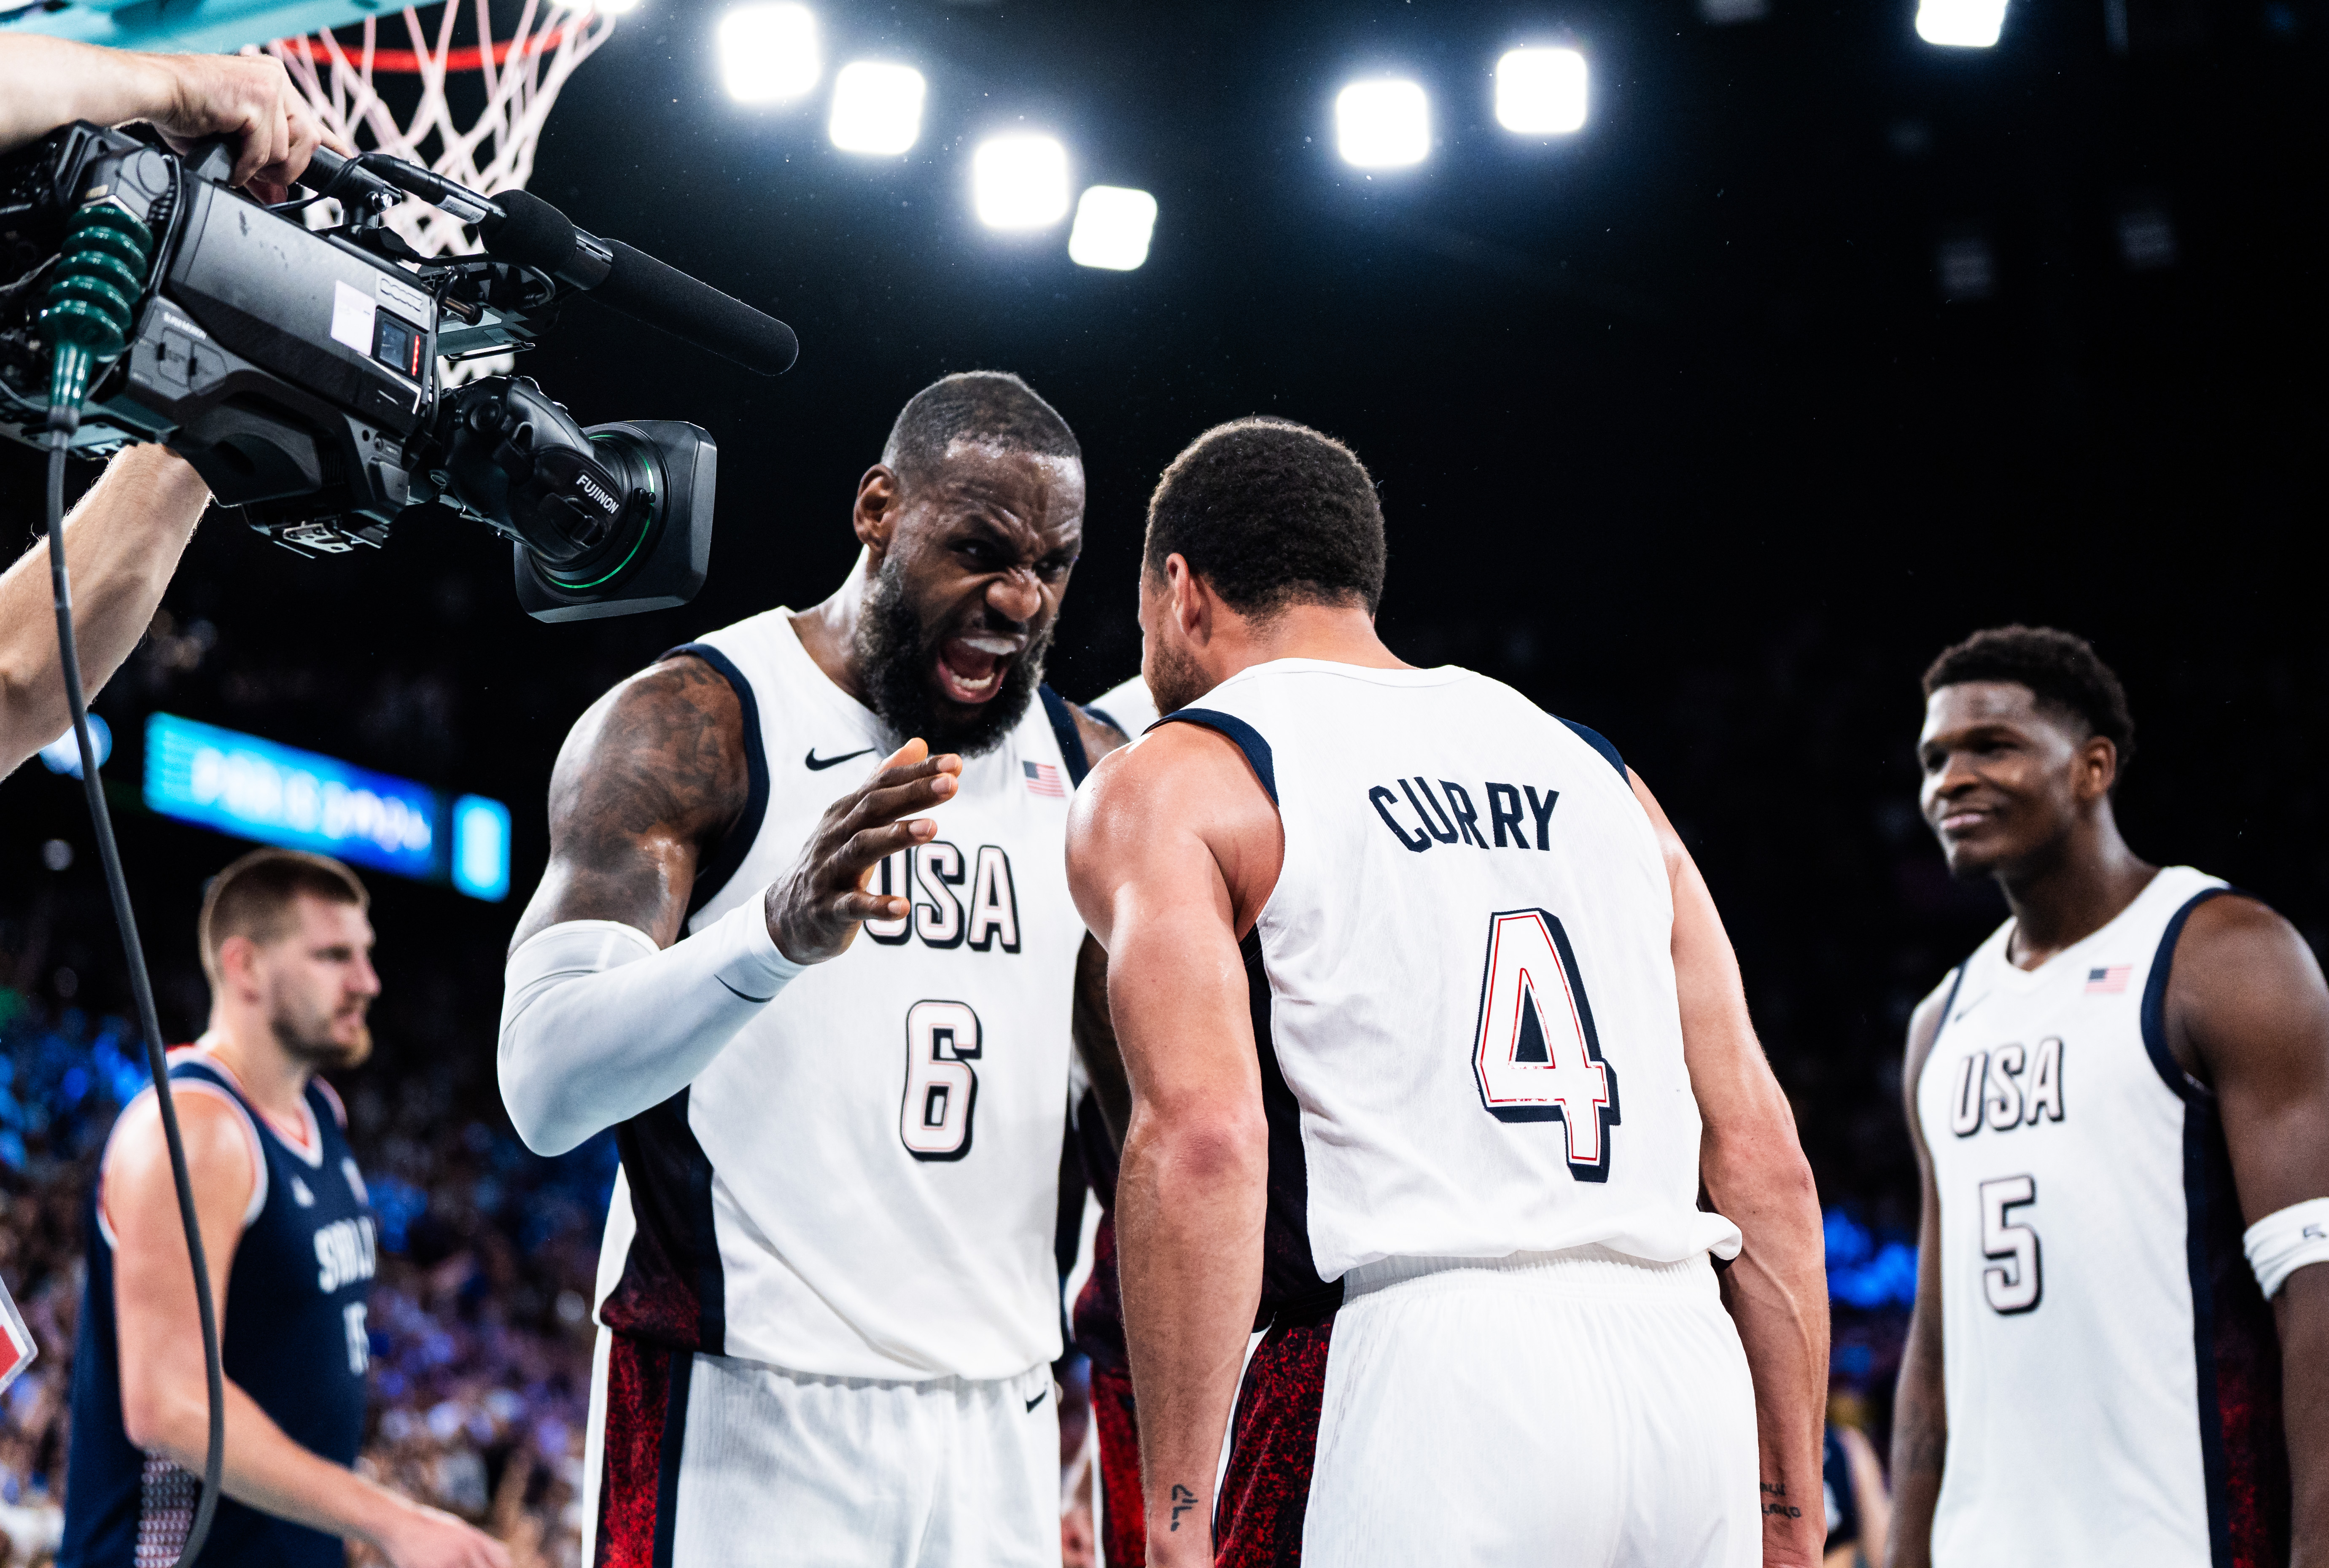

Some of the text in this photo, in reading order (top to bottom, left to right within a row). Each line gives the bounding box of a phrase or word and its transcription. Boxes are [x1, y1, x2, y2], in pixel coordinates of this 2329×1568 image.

[576, 475, 619, 514] FUJINON
[1368, 776, 1560, 853] CURRY
[900, 999, 983, 1162] 6
[1472, 907, 1621, 1183] 4
[1951, 1036, 2065, 1137] USA
[1979, 1174, 2043, 1315] 5
